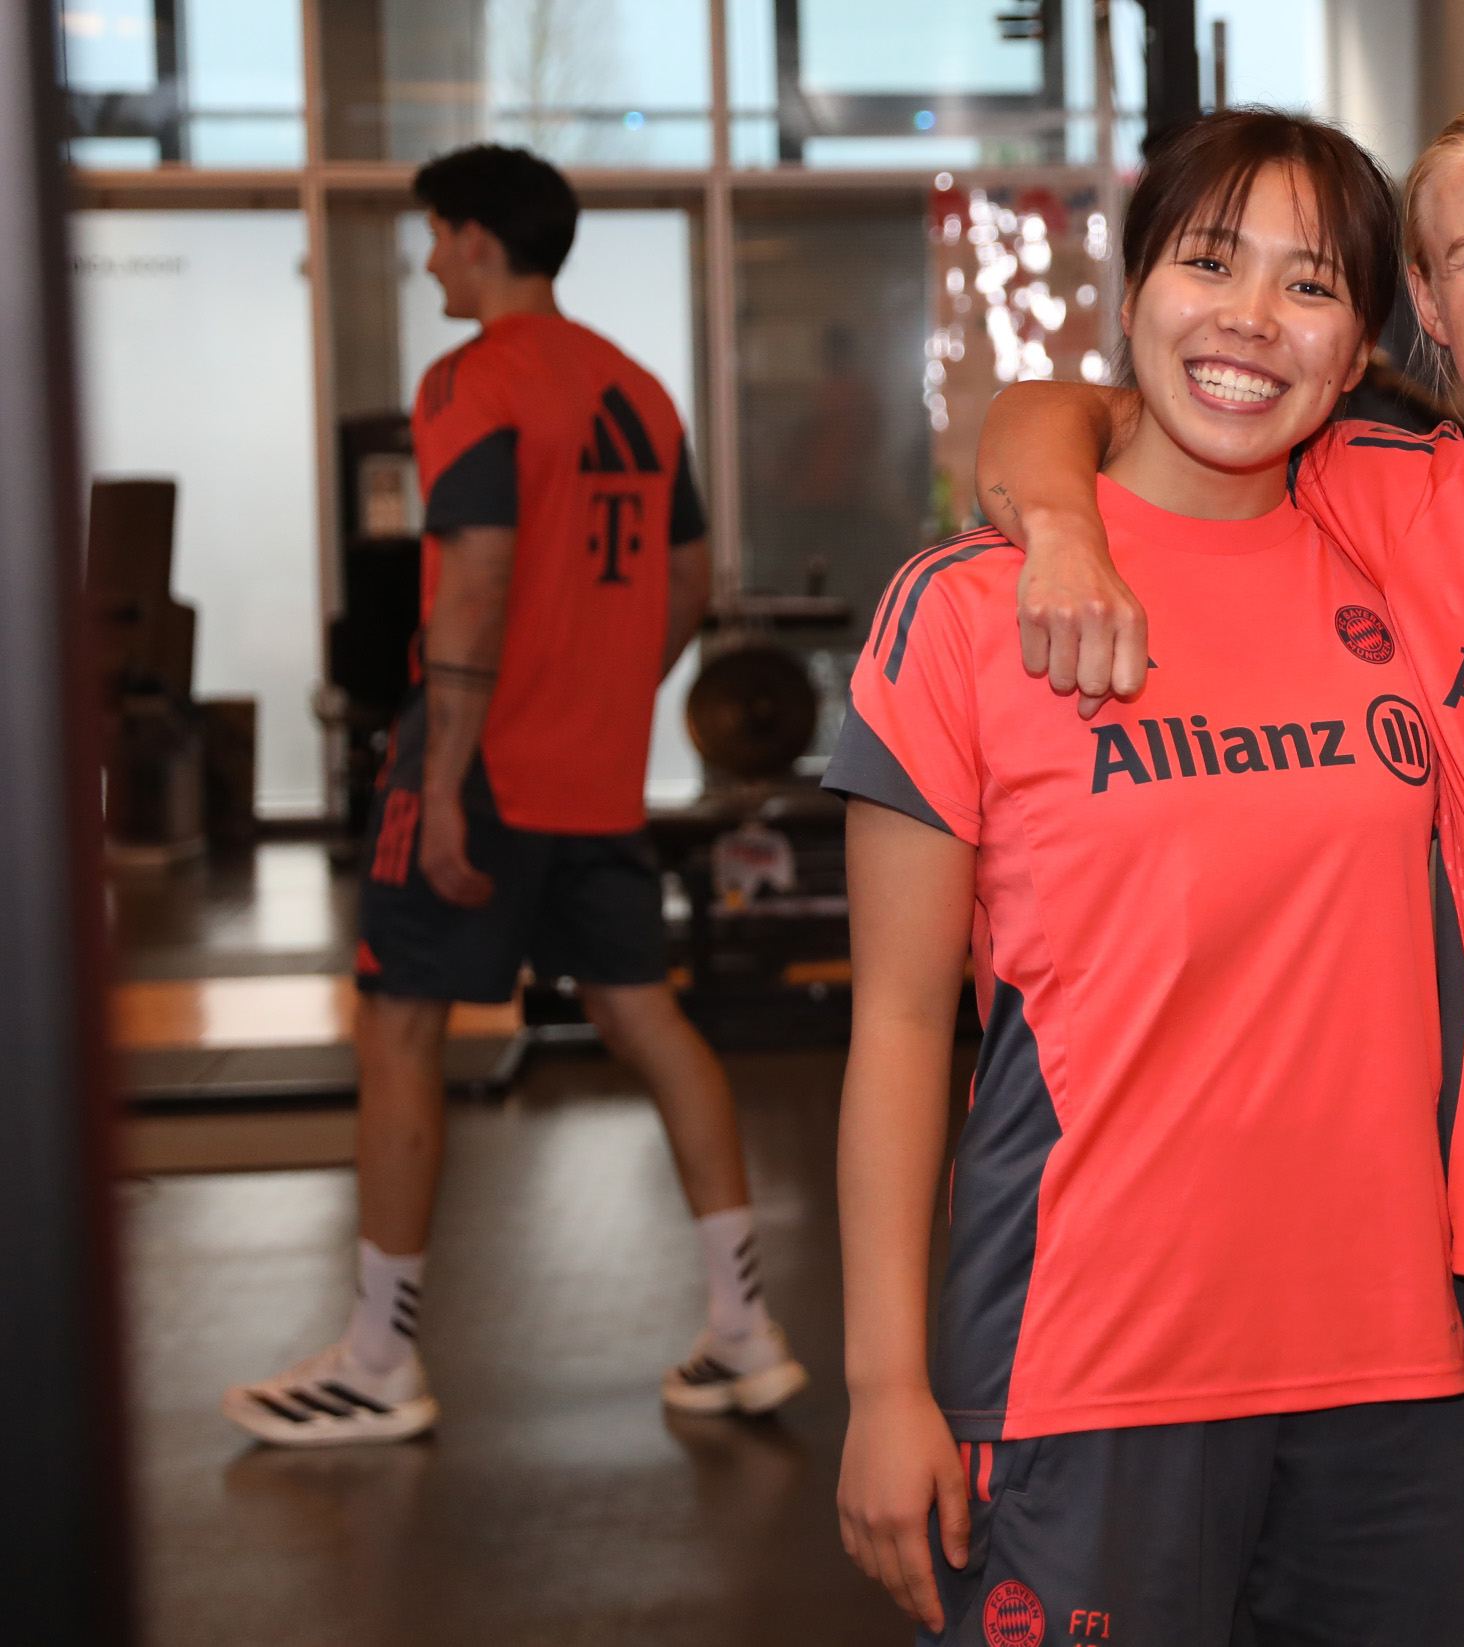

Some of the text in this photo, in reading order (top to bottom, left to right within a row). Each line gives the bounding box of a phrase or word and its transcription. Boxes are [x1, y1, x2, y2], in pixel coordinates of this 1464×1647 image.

[1342, 609, 1384, 631] BAYERN
[1090, 714, 1357, 795] Allianz
[990, 1586, 1040, 1619] FC BAYERN
[1069, 1609, 1110, 1639] FF1
